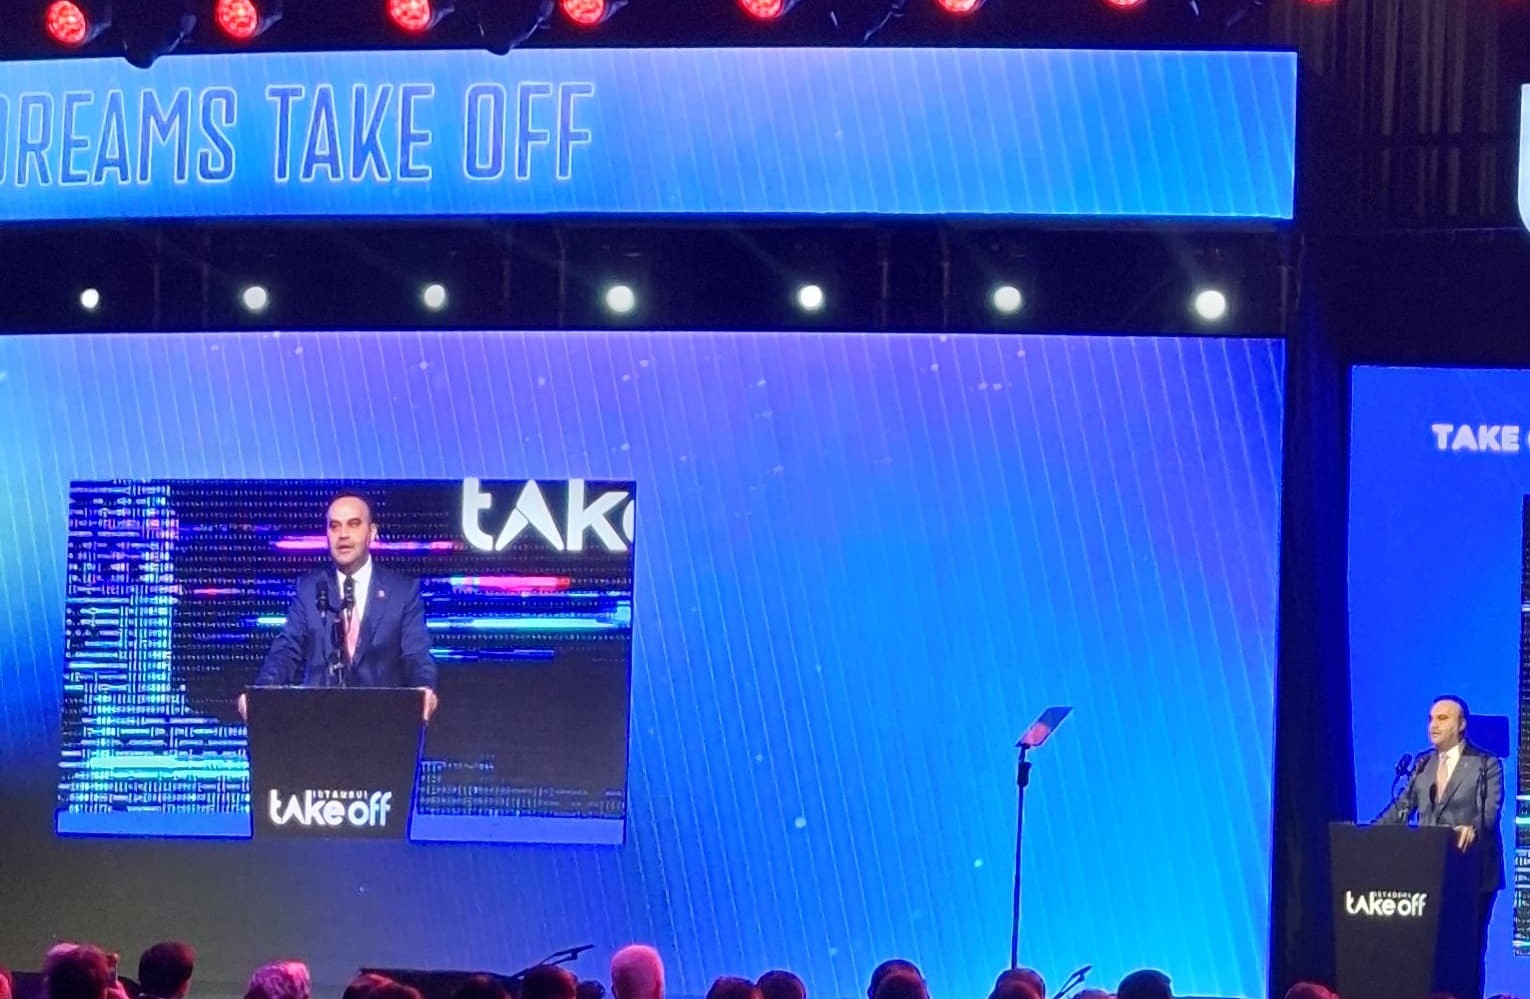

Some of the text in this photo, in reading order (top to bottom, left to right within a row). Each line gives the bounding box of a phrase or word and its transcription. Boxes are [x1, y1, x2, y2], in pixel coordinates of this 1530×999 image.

[0, 80, 594, 188] REAMS TAKE OFF
[1432, 423, 1520, 451] TAKE
